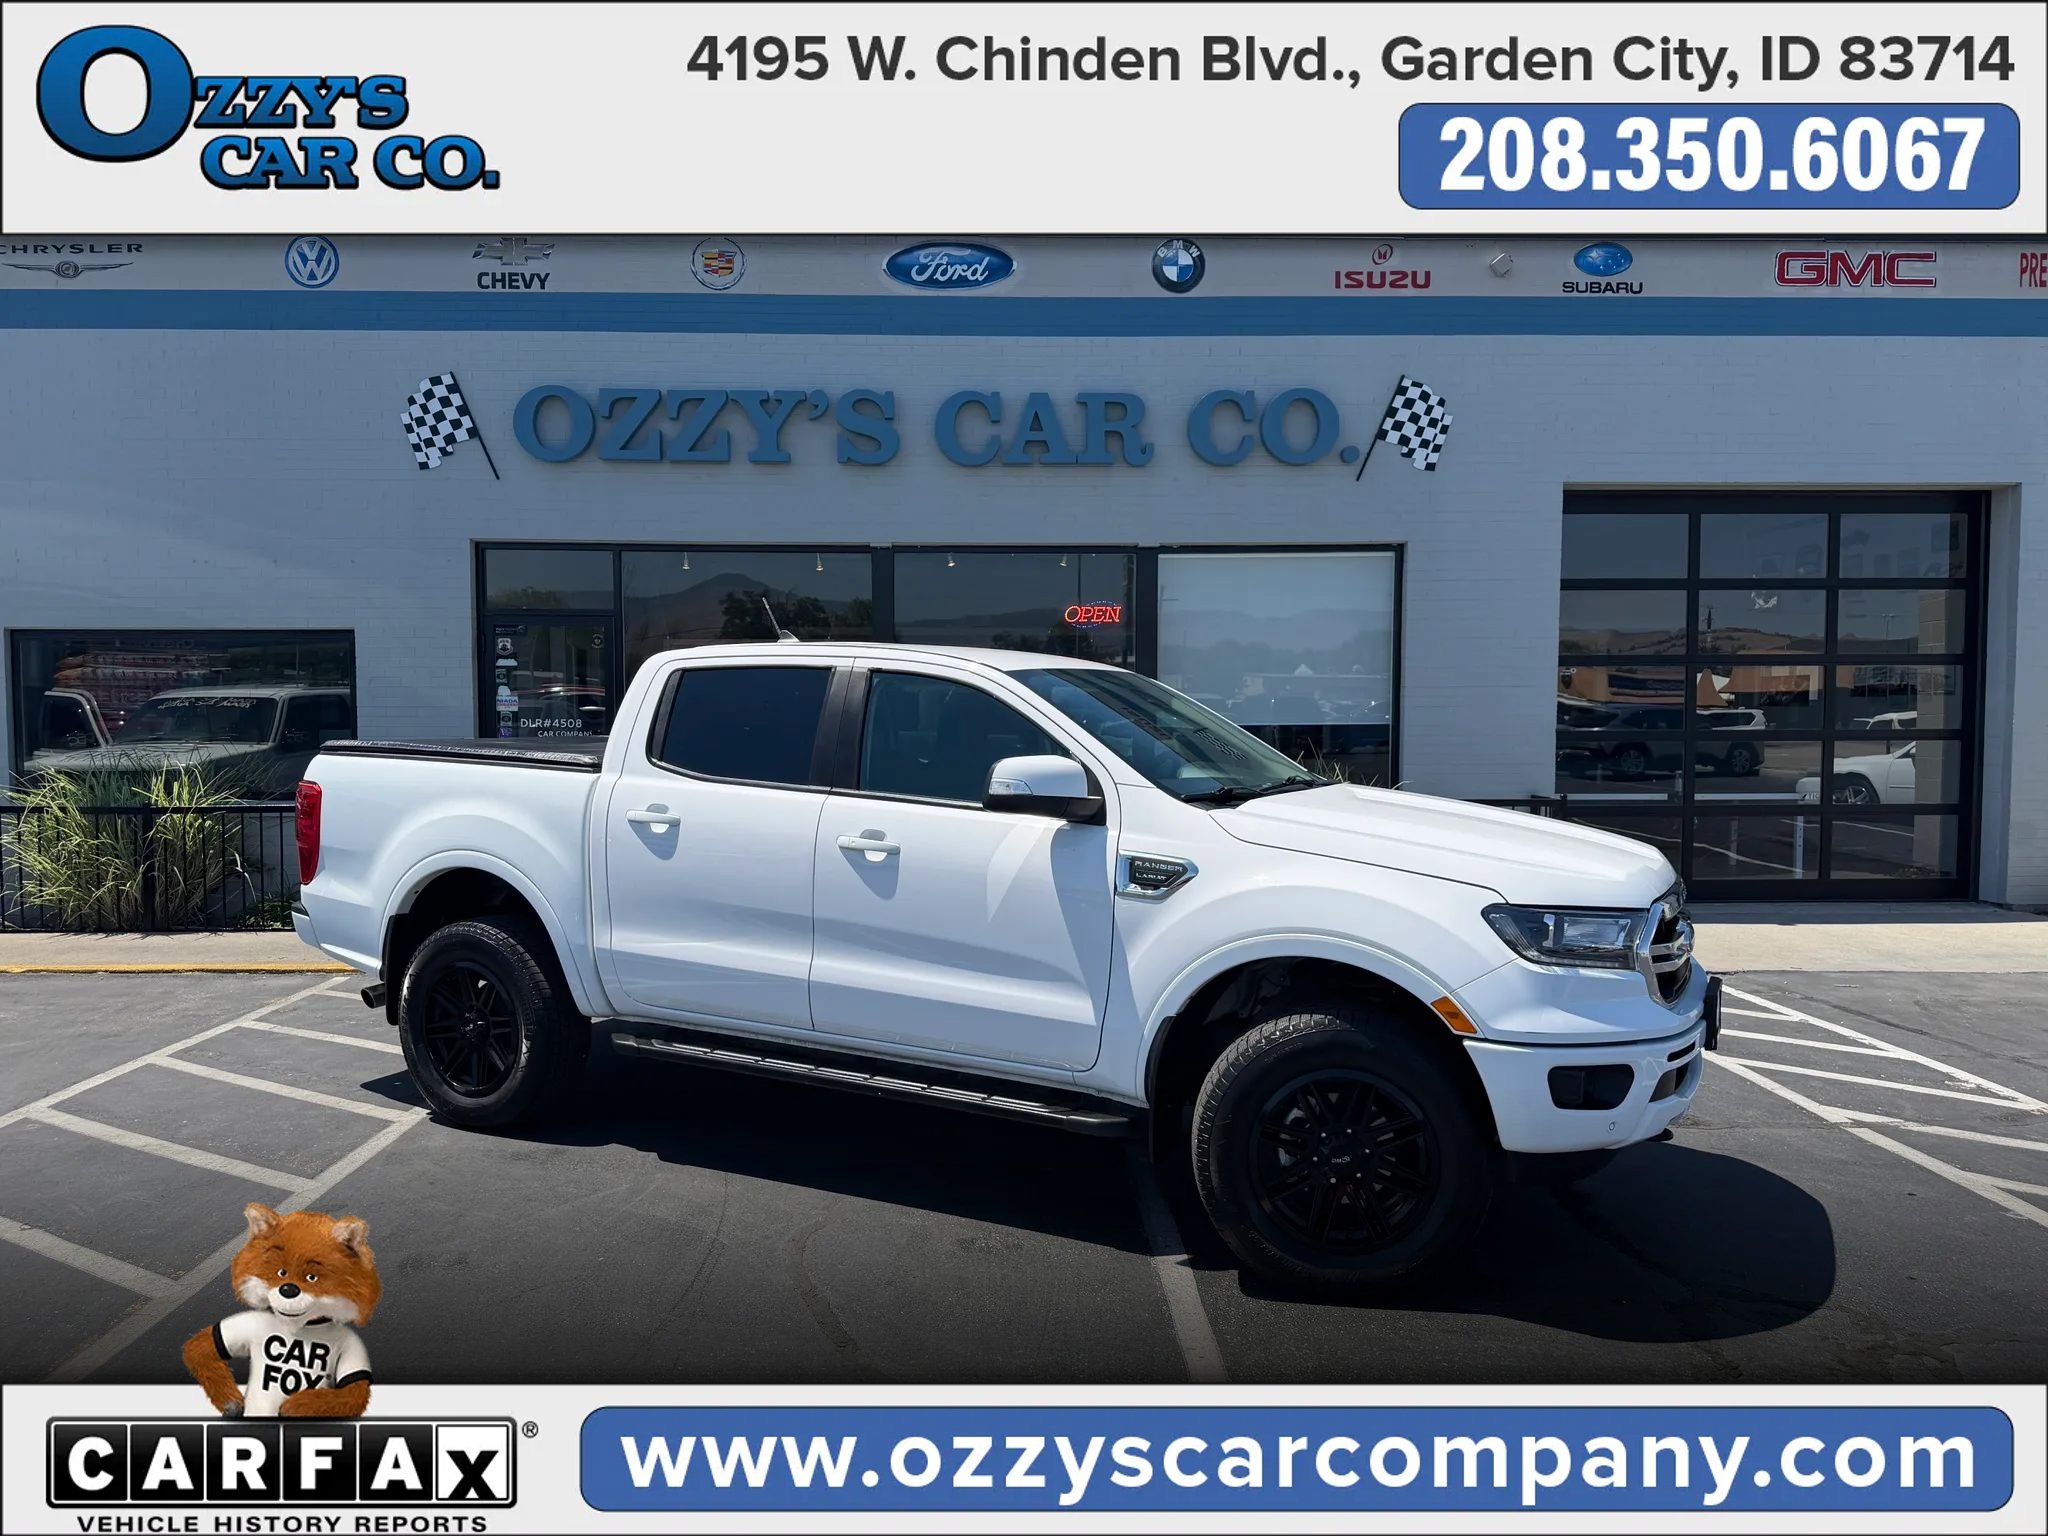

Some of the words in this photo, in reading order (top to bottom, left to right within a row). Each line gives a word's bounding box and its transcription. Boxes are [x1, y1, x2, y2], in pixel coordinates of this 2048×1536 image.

[1157, 240, 1200, 258] BMW
[910, 247, 990, 282] Ford
[1774, 250, 1937, 288] GMC
[477, 271, 551, 290] CHEVY
[1334, 270, 1431, 289] ISUZU
[1561, 281, 1644, 295] SUBARU
[513, 385, 900, 466] OZZY'S
[934, 390, 1155, 468] CAR
[1187, 387, 1361, 467] CO.
[1064, 605, 1122, 623] OPEN
[520, 718, 583, 728] DLR#4508
[264, 1334, 330, 1372] CAR
